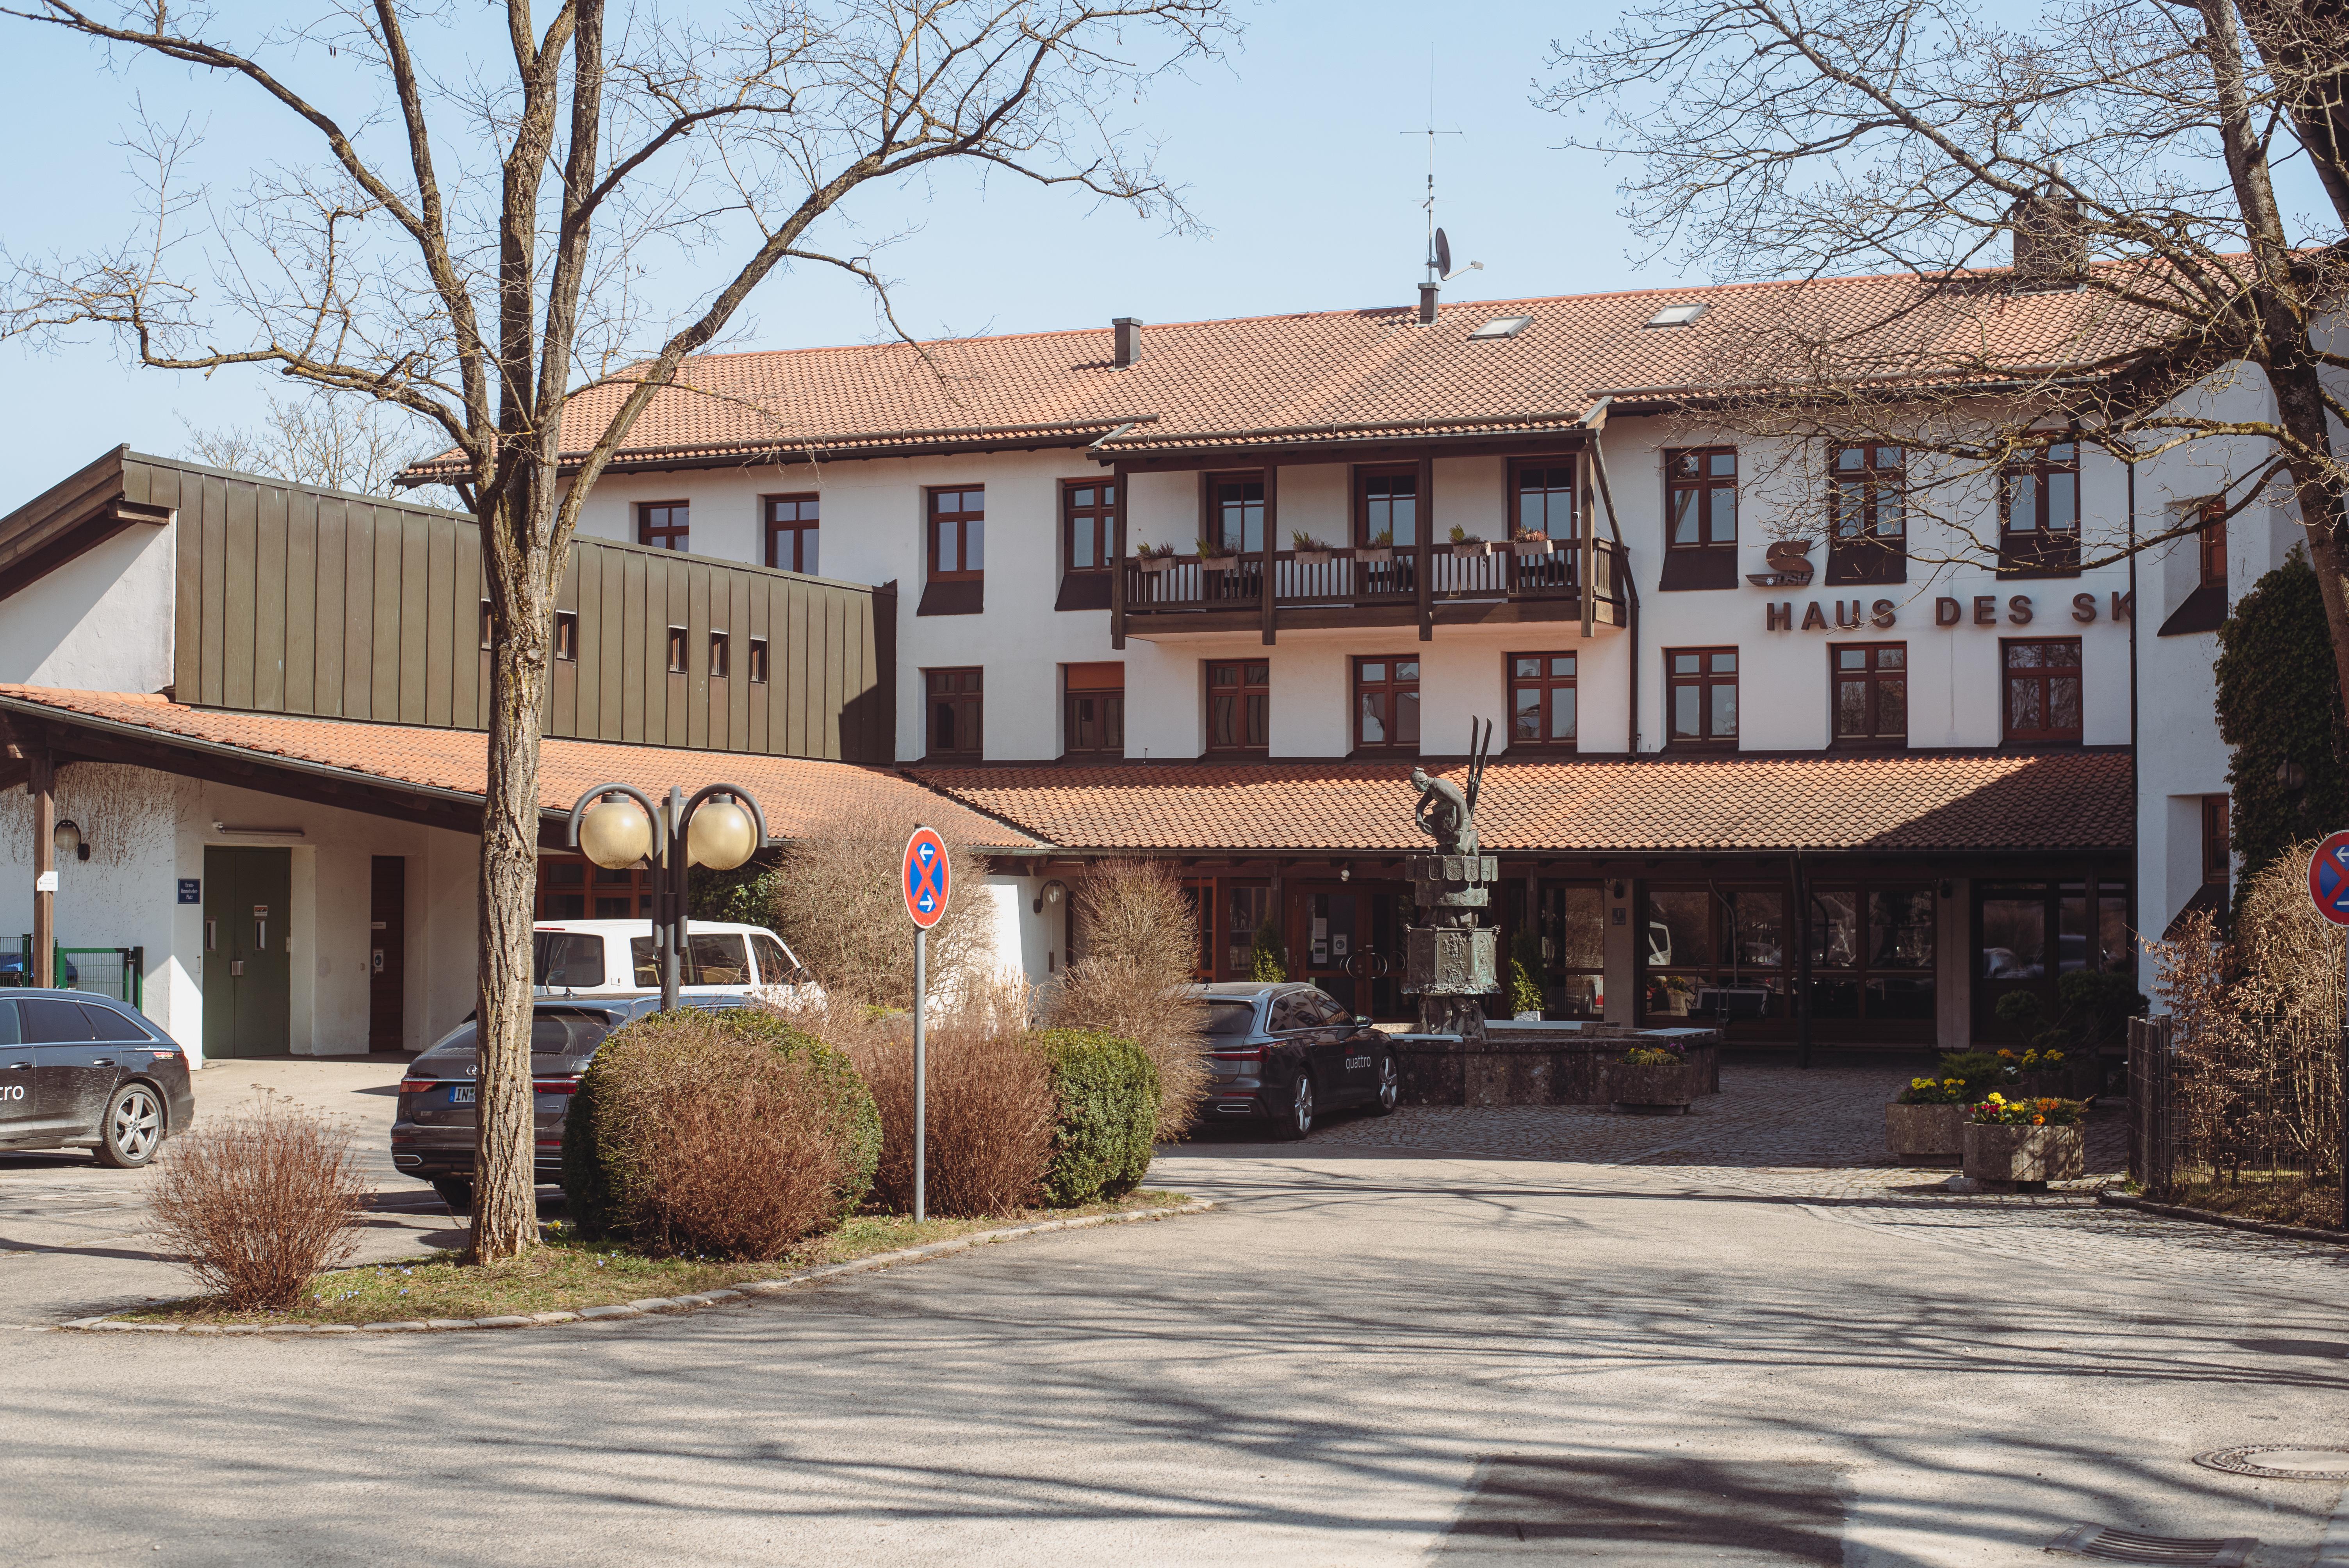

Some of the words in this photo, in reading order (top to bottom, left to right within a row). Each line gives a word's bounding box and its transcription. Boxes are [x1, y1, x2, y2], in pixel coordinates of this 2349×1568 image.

[1767, 599, 1896, 631] HAUS
[1936, 595, 2034, 625] DES
[2072, 591, 2131, 622] SK
[1346, 1055, 1371, 1073] quattro
[456, 1089, 469, 1101] IN
